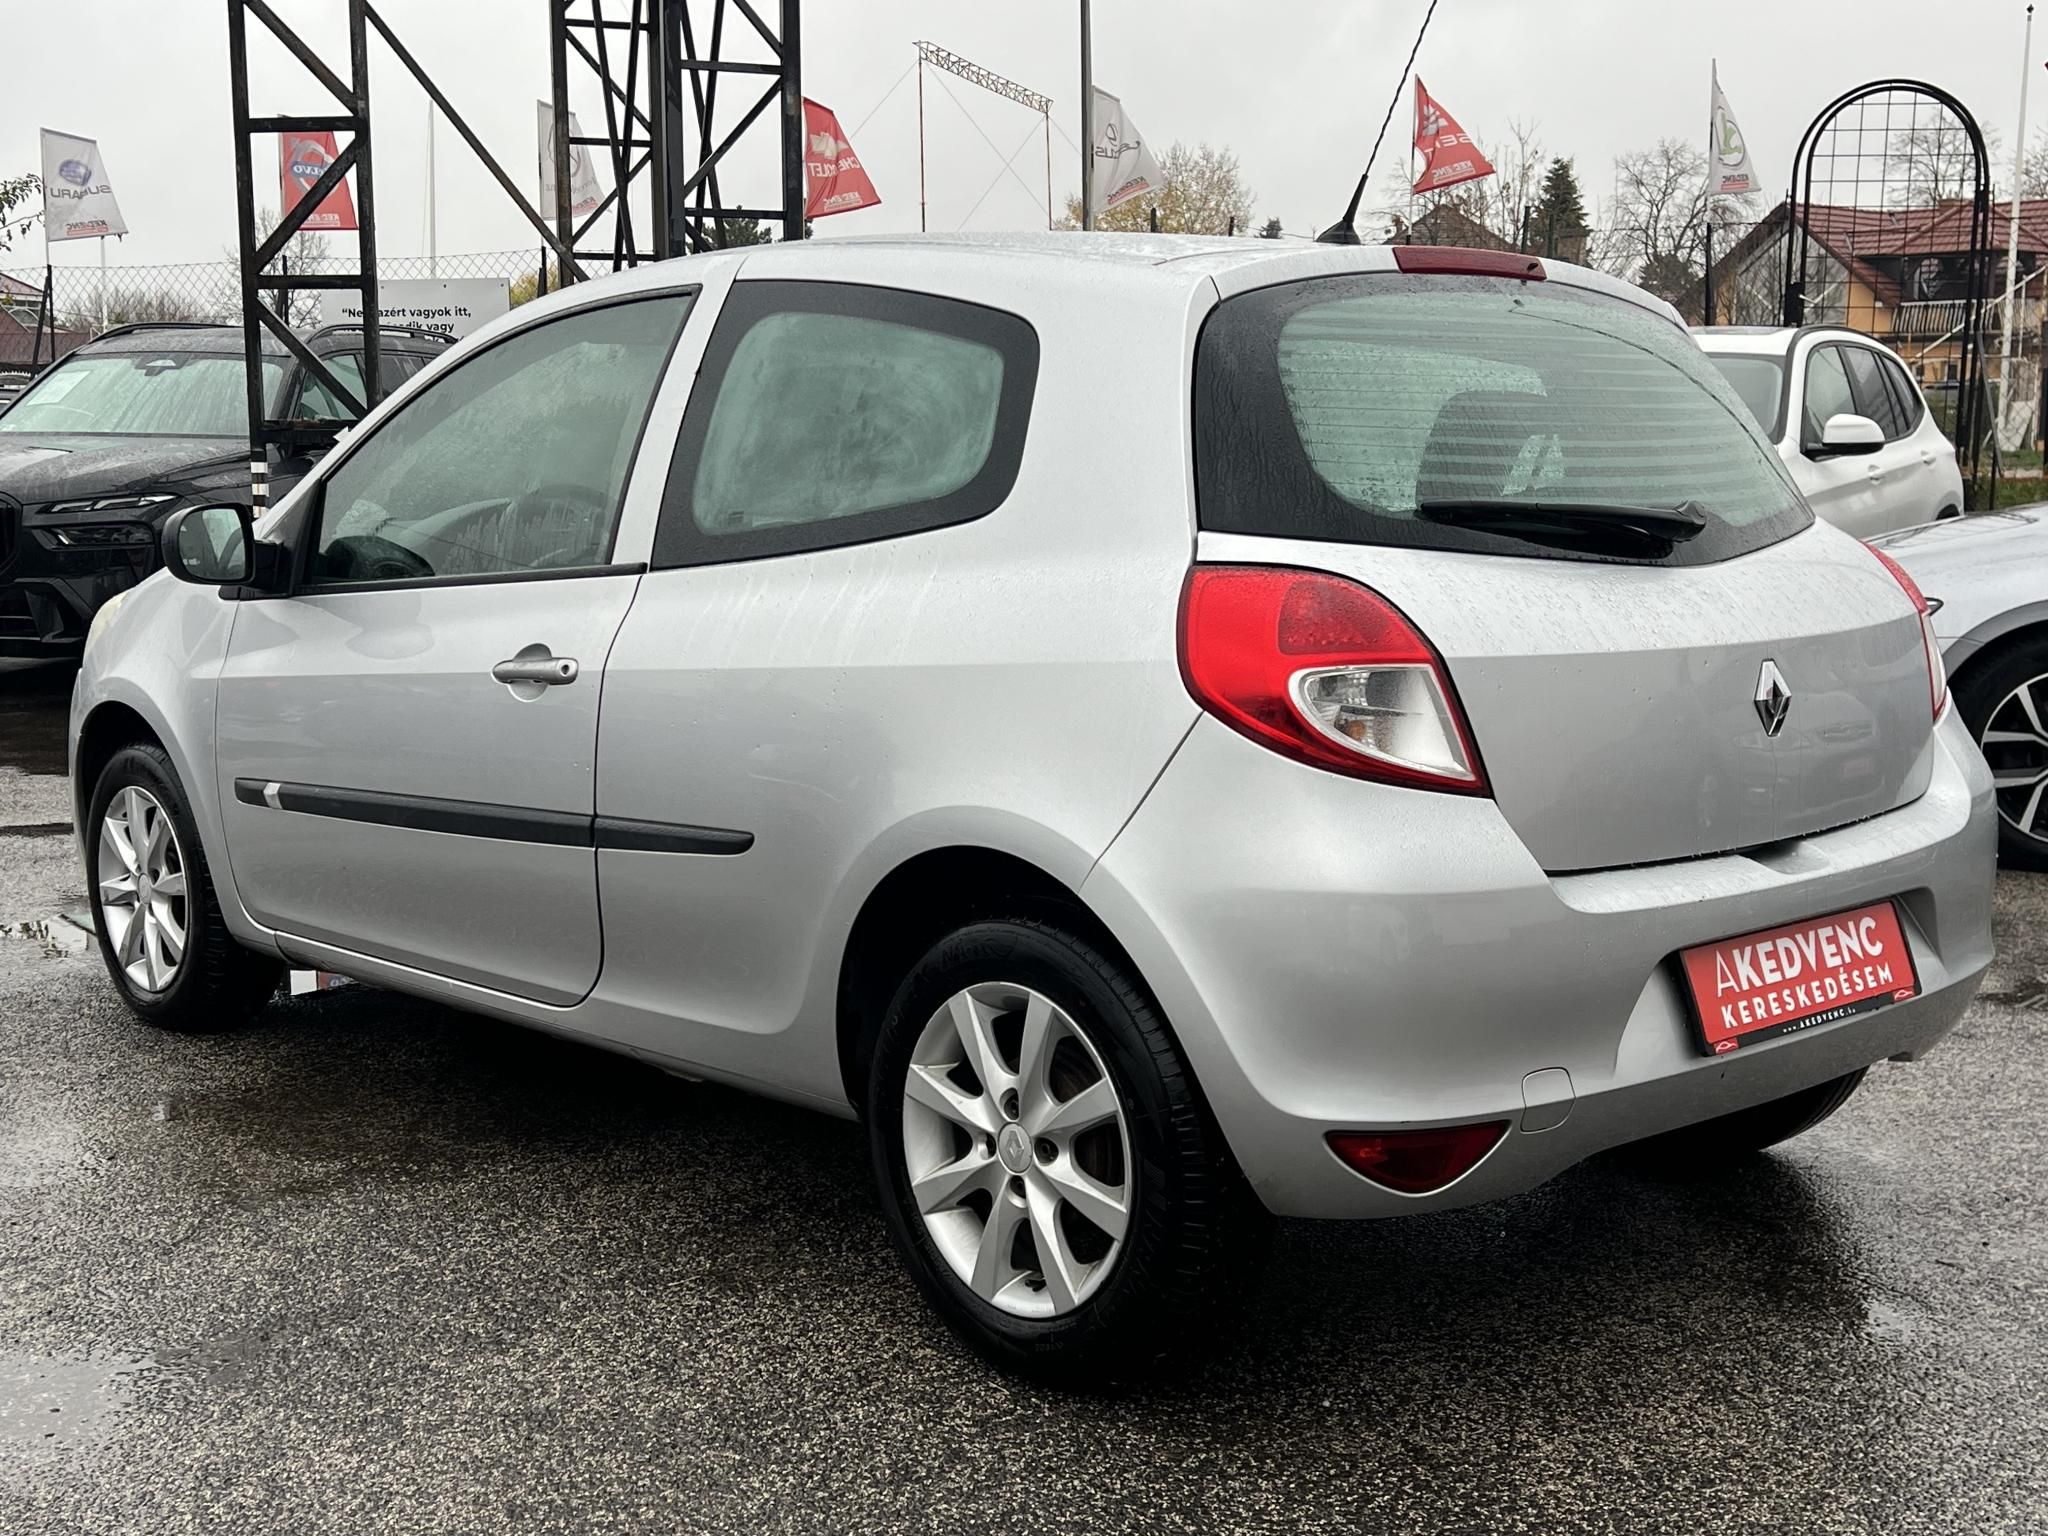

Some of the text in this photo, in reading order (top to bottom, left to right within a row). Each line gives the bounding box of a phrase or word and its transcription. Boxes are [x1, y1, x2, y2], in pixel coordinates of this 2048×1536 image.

[409, 306, 452, 320] vagyok
[454, 305, 472, 319] itt,
[1720, 961, 1894, 1030] KERESKEDÉSEM
